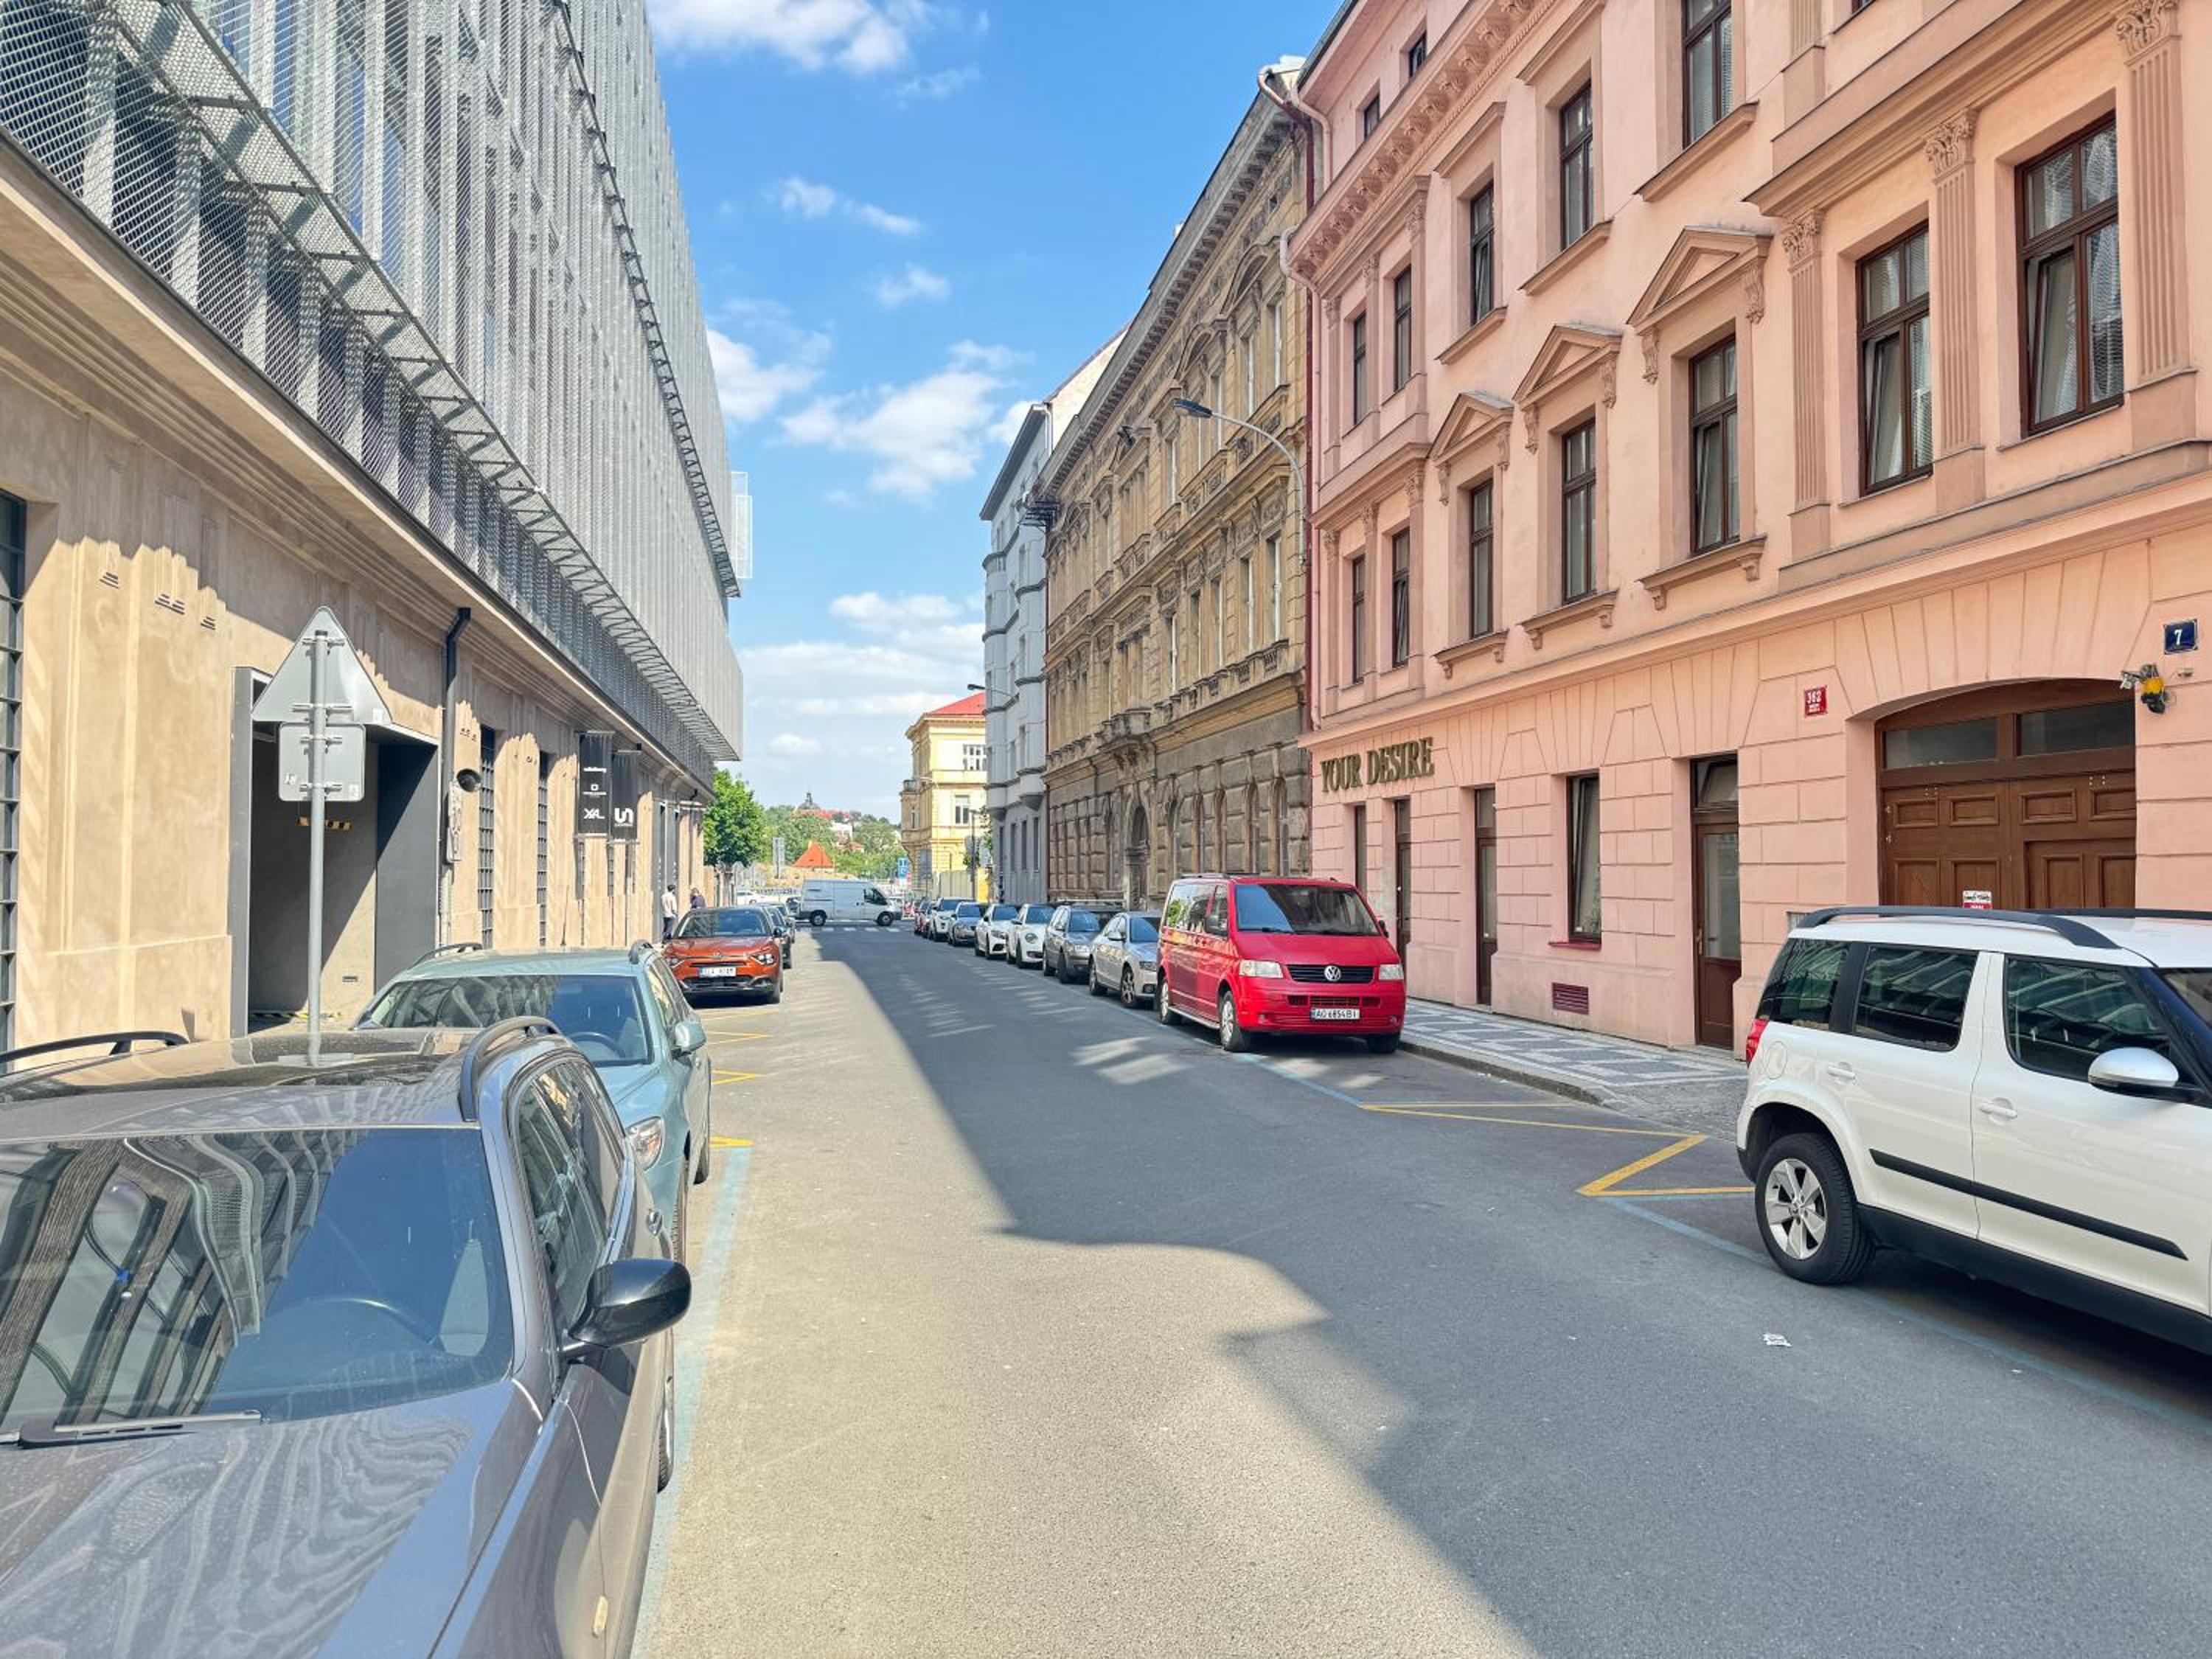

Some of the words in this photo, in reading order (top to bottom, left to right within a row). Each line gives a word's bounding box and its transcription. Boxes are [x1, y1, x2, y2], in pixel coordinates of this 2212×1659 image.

[2174, 629, 2183, 646] 7
[1320, 754, 1363, 793] YOUR
[1366, 737, 1435, 785] DESIRE
[583, 808, 605, 819] XAL
